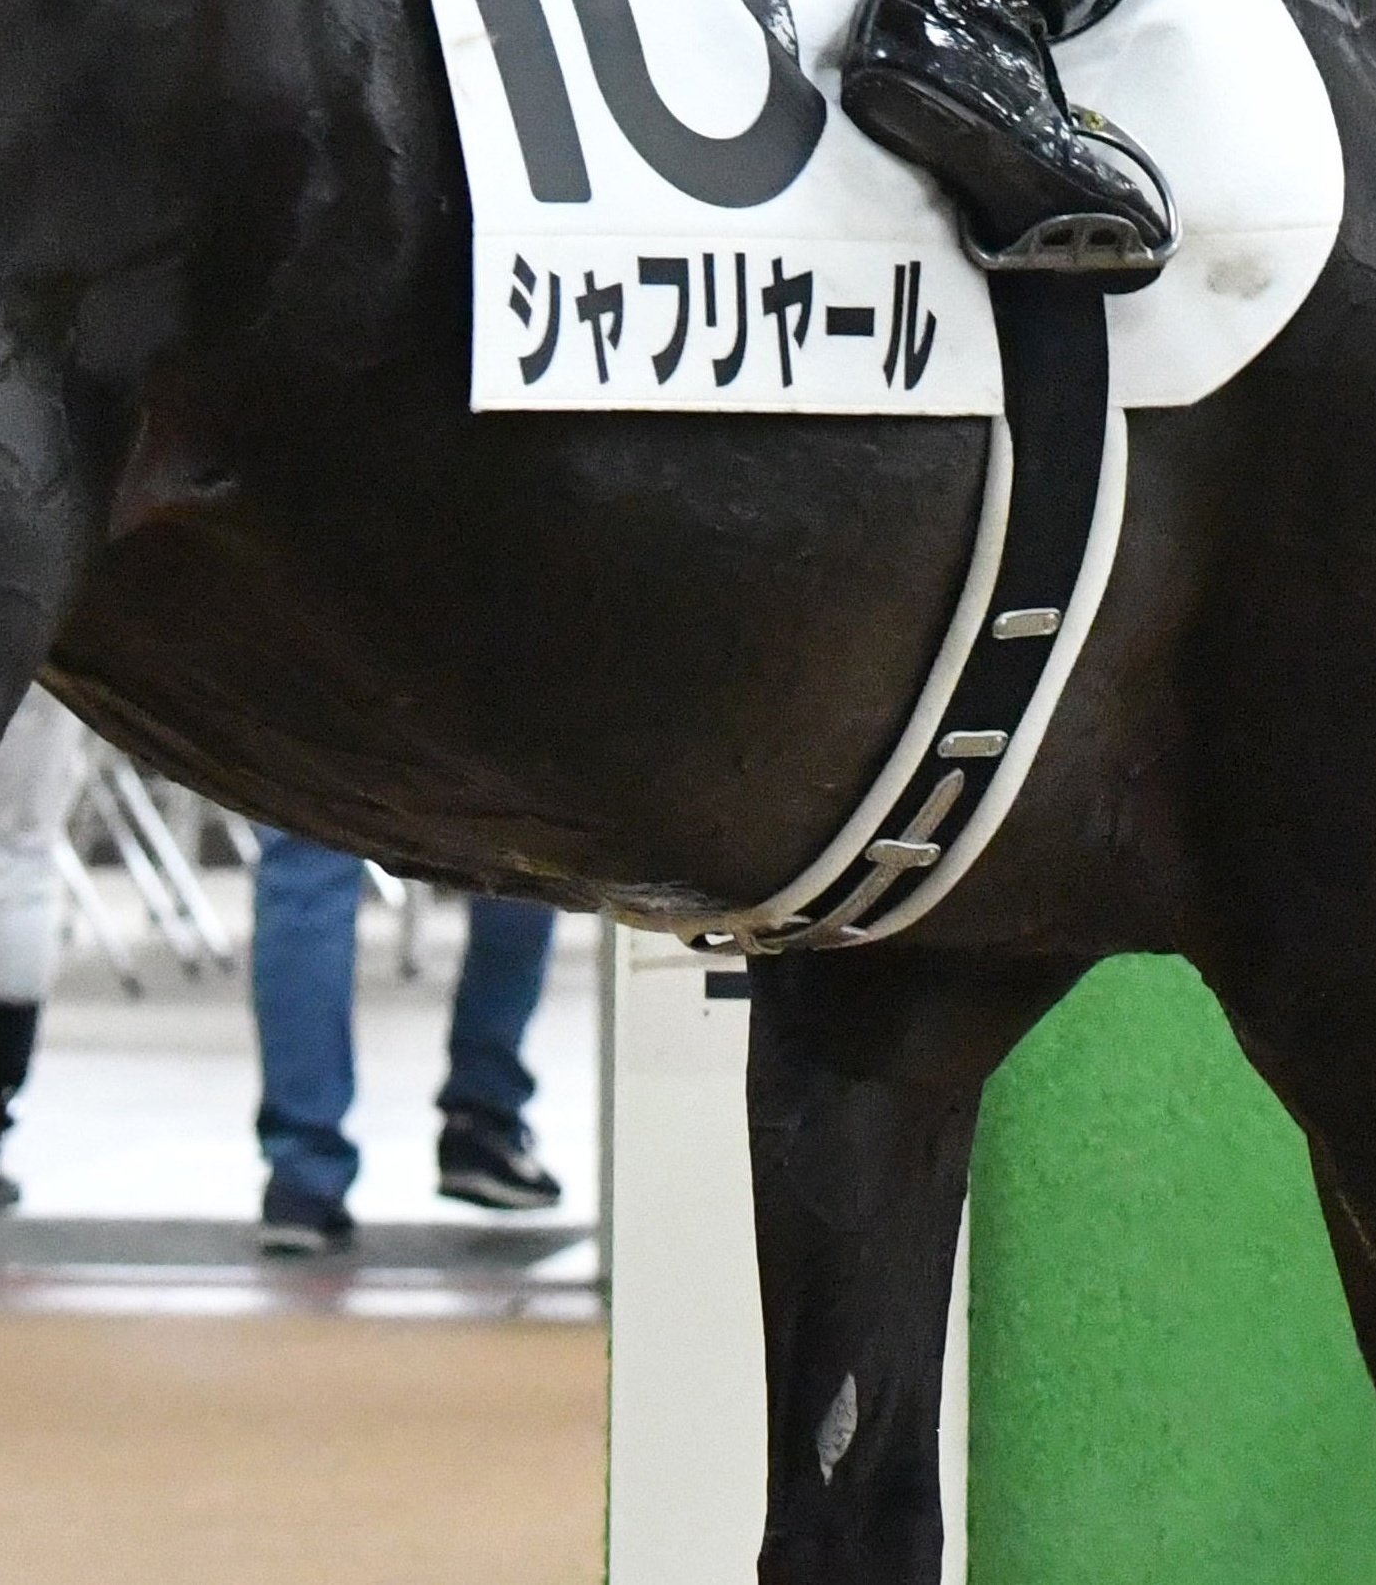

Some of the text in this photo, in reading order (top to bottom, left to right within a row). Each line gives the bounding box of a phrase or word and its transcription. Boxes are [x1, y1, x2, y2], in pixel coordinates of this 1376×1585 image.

[508, 251, 938, 391] シャフリヤール
